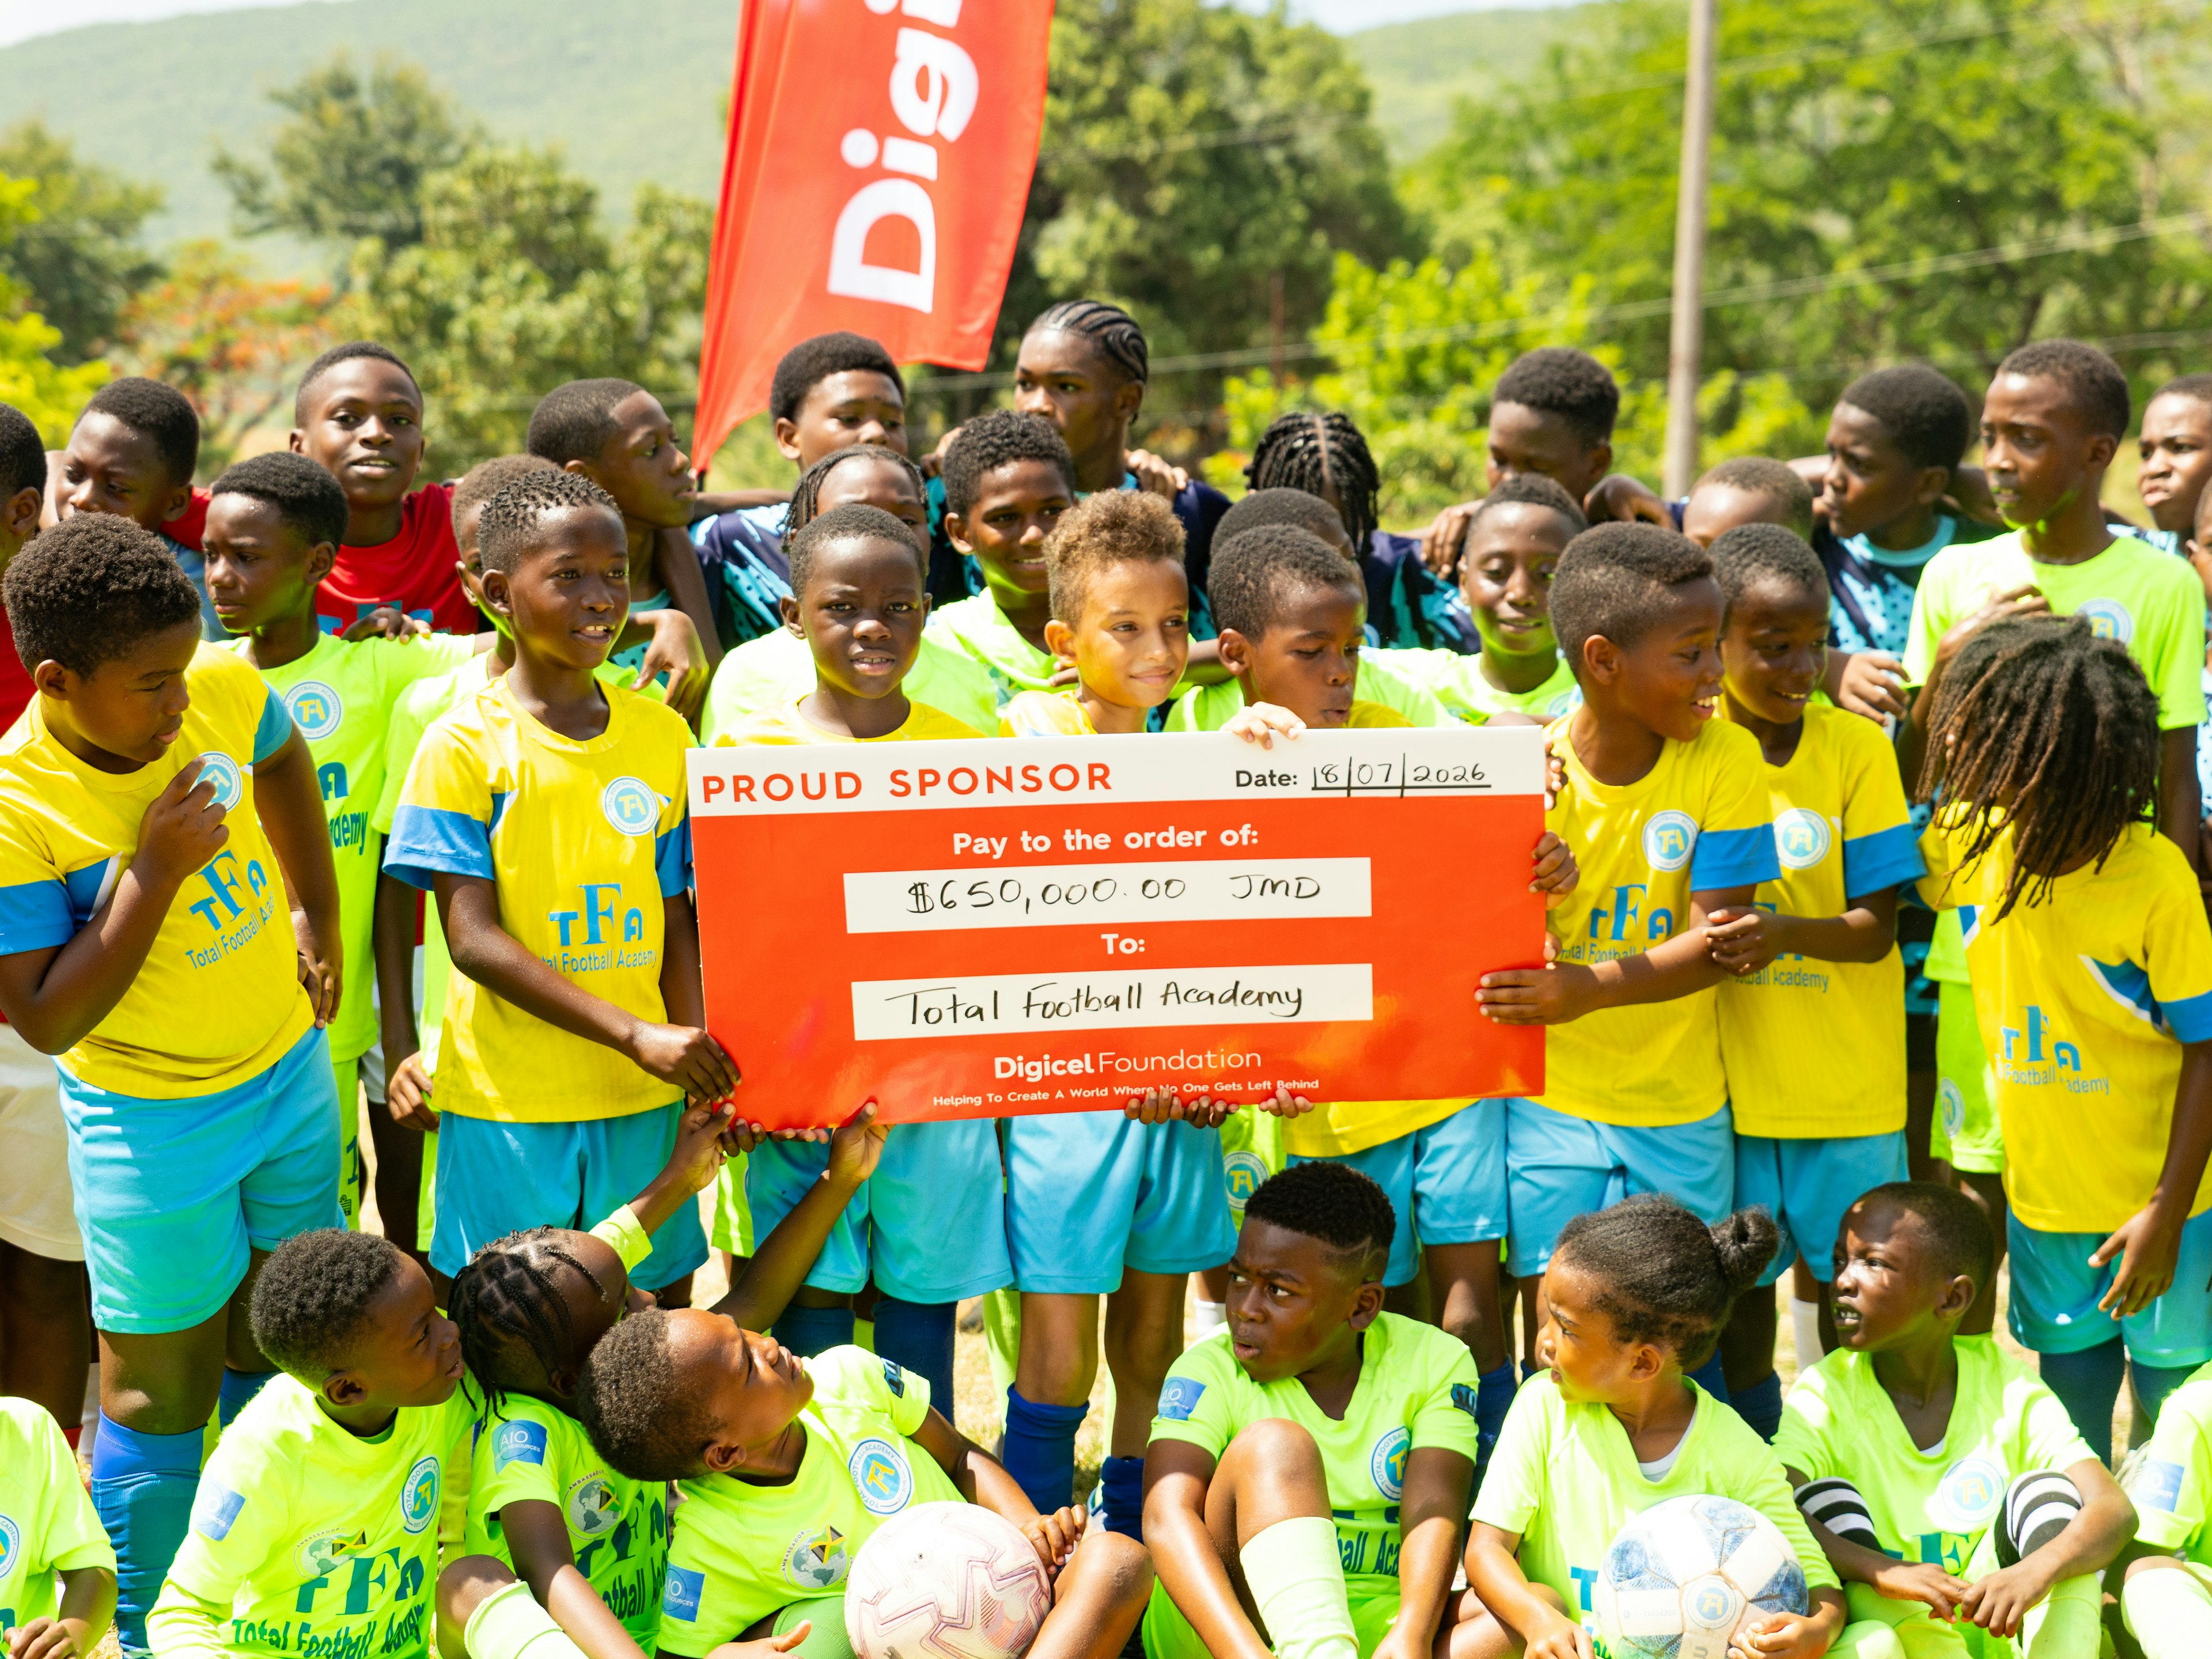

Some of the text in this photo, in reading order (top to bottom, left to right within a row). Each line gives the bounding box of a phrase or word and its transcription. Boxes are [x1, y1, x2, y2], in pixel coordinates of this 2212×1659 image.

[212, 756, 237, 777] ACADEMY
[1236, 770, 1298, 787] Date:
[702, 763, 1113, 803] PROUD SPONSOR
[953, 823, 1259, 859] Pay to the order of:
[1229, 874, 1320, 899] JMD
[548, 882, 643, 947] TFA
[185, 941, 222, 969] Total
[221, 912, 261, 955] Football
[1100, 933, 1145, 955] To:
[562, 949, 613, 972] Football
[616, 946, 657, 969] Academy
[885, 980, 1302, 1025] Total Football Academy
[994, 1048, 1262, 1083] Digicel Foundation
[2005, 1063, 2056, 1085] Football
[933, 1094, 982, 1107] Helping
[986, 1093, 1003, 1103] To
[1007, 1090, 1050, 1102] Create
[1055, 1089, 1065, 1099] A
[1070, 1087, 1108, 1097] World
[1113, 1085, 1154, 1095] Where
[1183, 1082, 1210, 1093] One
[1214, 1081, 1243, 1092] Gets
[1248, 1080, 1272, 1090] Left
[1277, 1079, 1320, 1090] Behind
[501, 1430, 528, 1449] AIO
[507, 1443, 541, 1452] RESOURCES
[409, 1462, 433, 1487] FOOTBALL
[853, 1444, 895, 1488] FOOTBALL ACADEMY
[1376, 1460, 1387, 1486] TOTAL
[859, 1489, 879, 1508] TOTAL
[297, 1527, 340, 1548] AMBASSADOR
[782, 1531, 805, 1571] AMBASSADOR
[296, 1547, 424, 1616] TFA
[232, 1619, 290, 1651] Total
